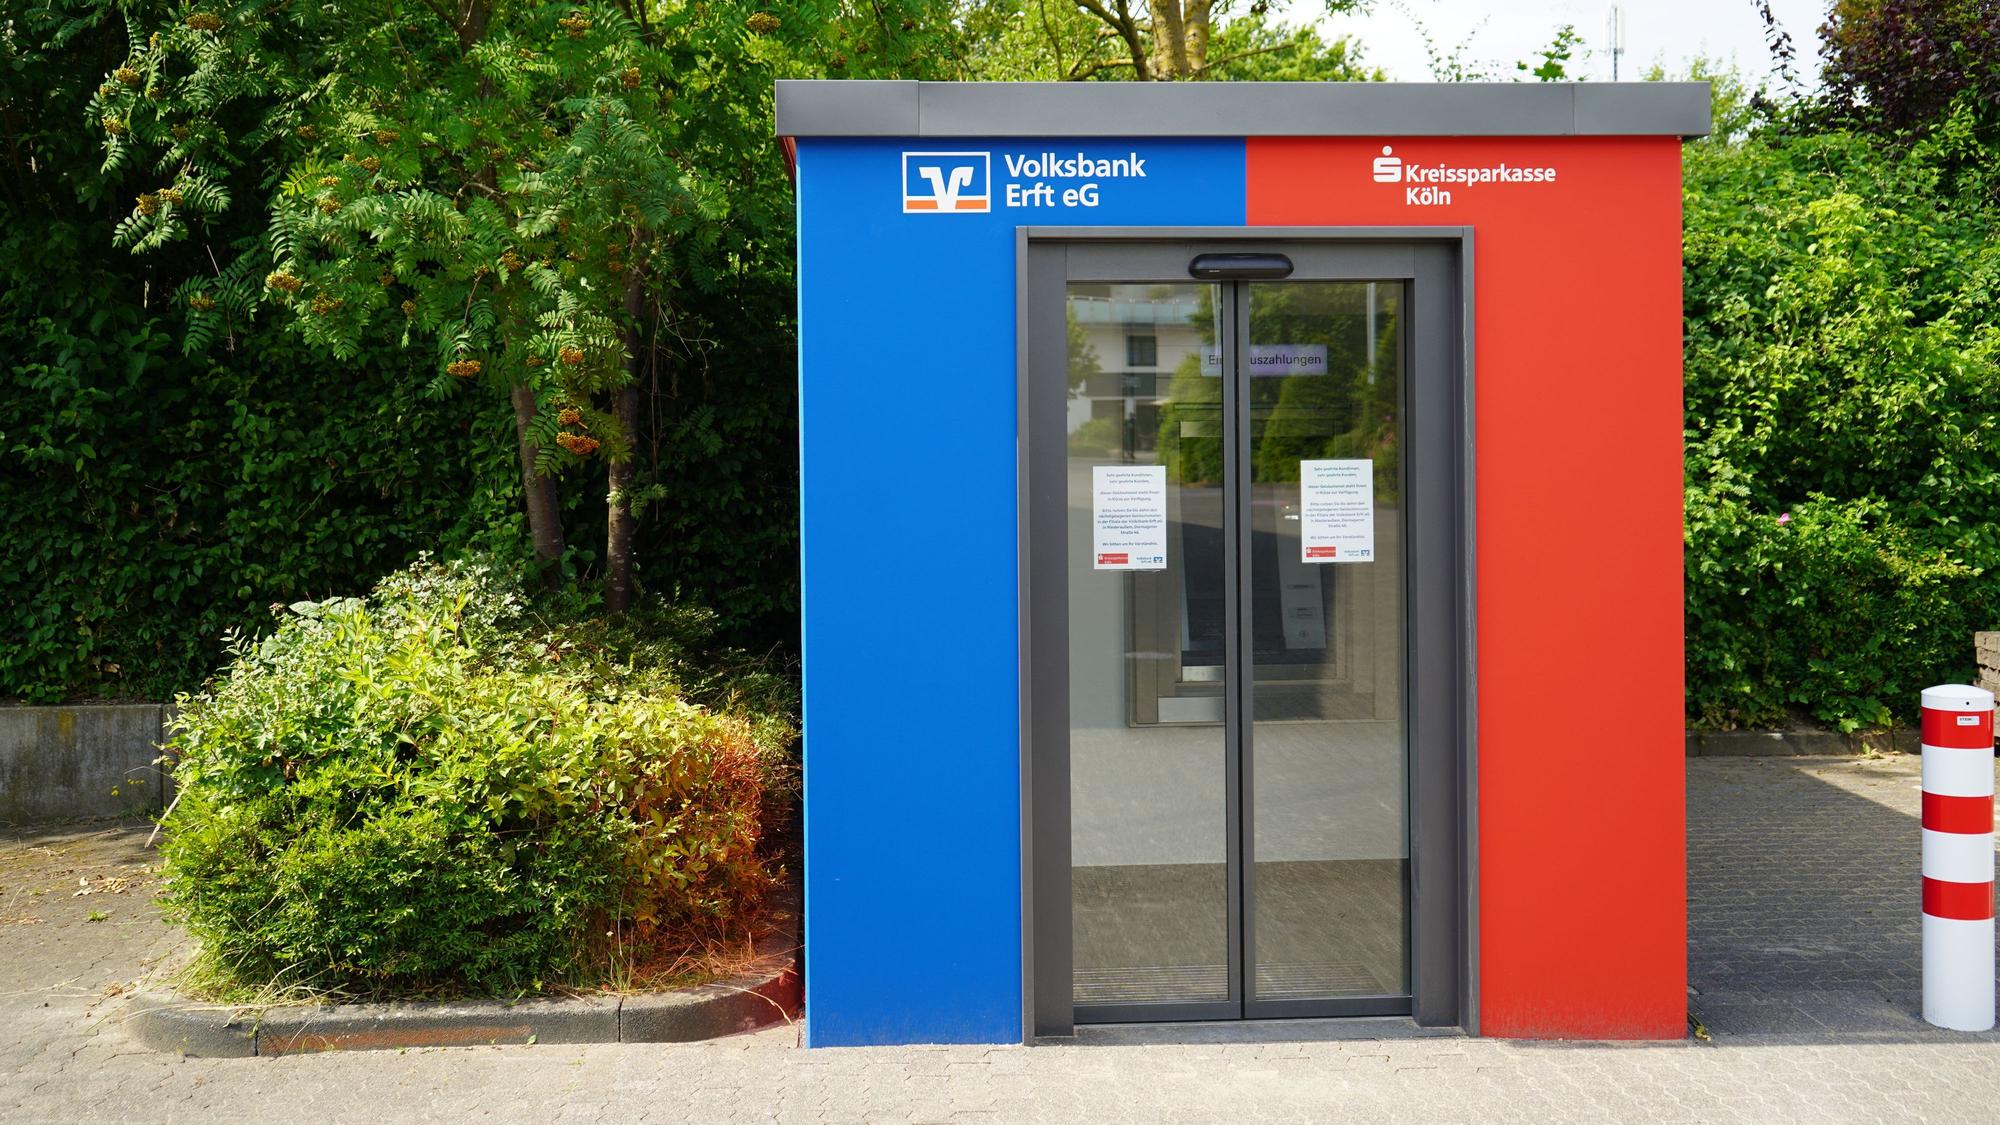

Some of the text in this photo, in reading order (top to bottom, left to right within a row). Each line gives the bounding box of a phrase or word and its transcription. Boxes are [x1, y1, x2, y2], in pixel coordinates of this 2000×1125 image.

[1004, 152, 1146, 178] Volksbank
[1406, 164, 1556, 187] Kreissparkasse
[1006, 182, 1099, 207] Erft eG
[1406, 186, 1451, 205] Köln
[1250, 354, 1322, 366] uszahlungen
